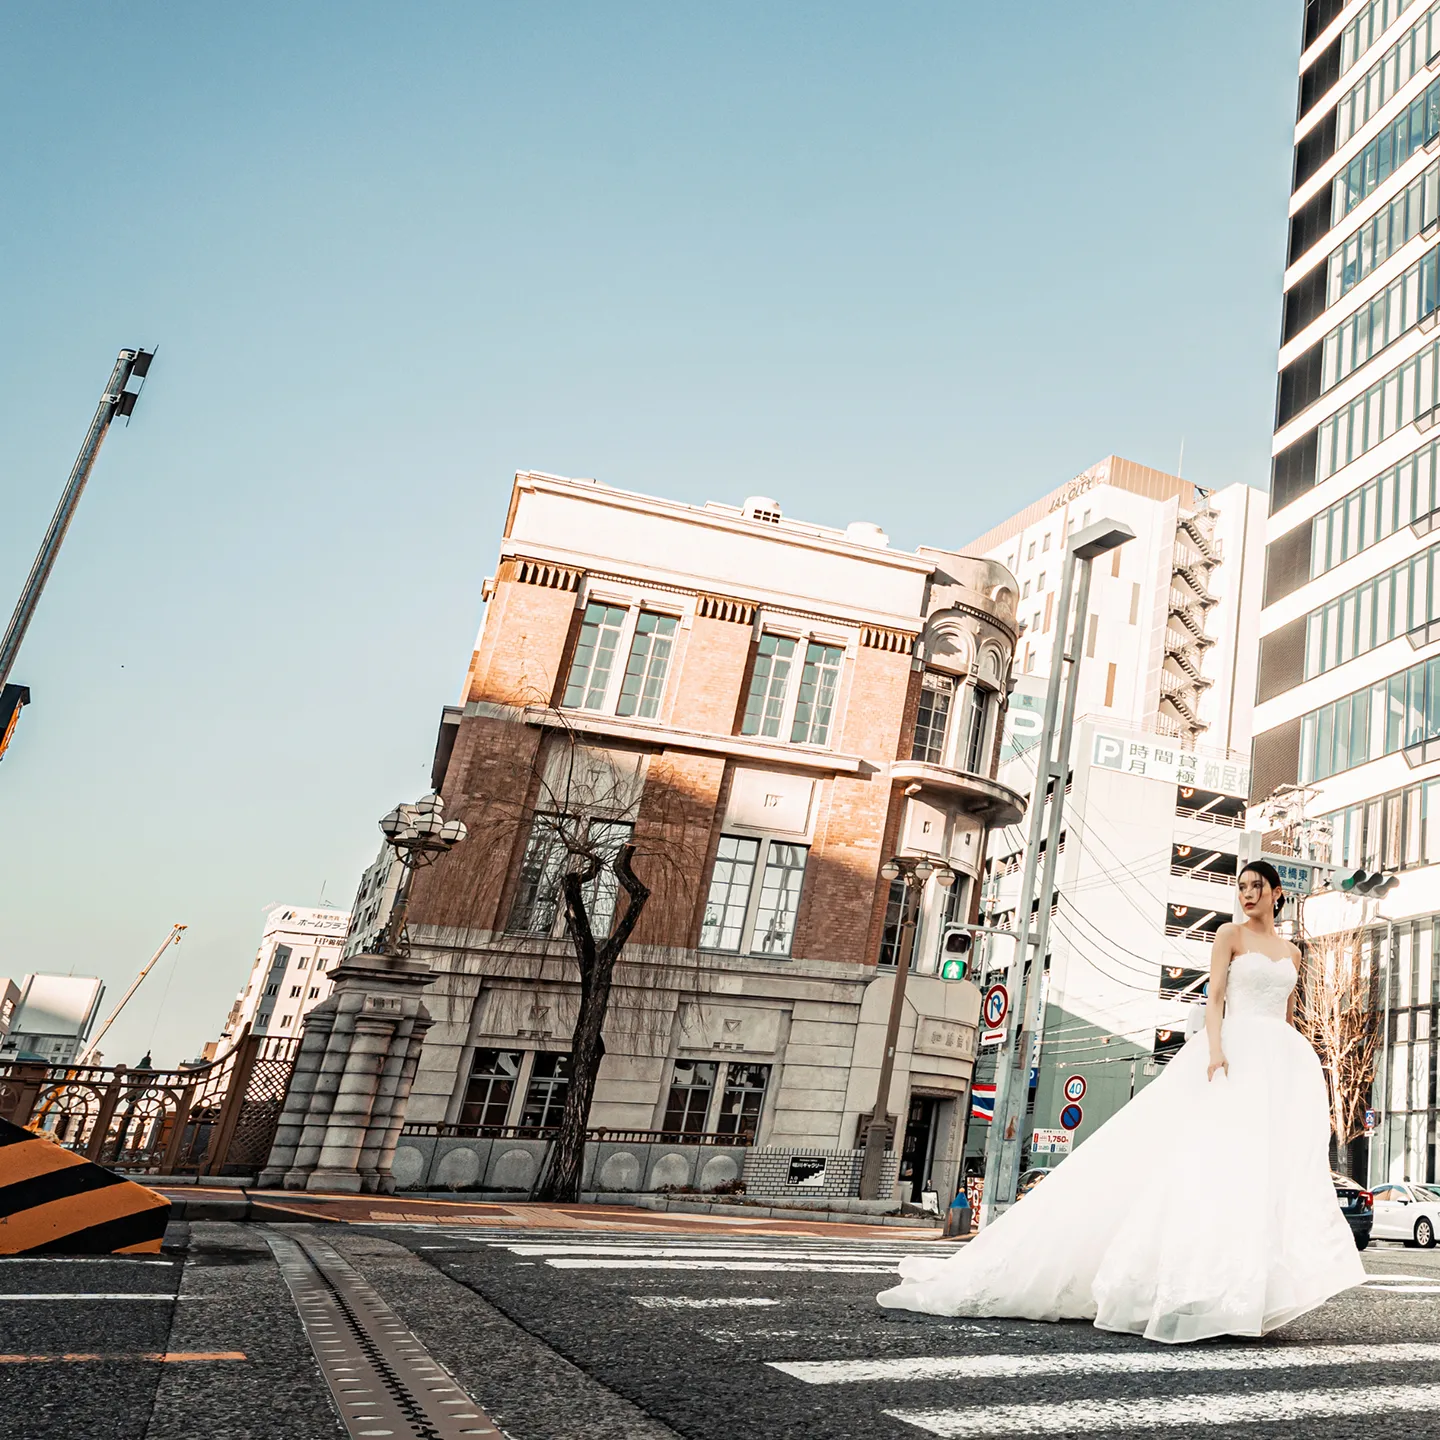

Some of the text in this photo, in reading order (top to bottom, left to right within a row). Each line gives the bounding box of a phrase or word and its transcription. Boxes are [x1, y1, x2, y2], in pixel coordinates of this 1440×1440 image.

[1098, 738, 1120, 764] P
[1129, 743, 1198, 771] 時間貸
[1273, 864, 1308, 882] 屋橋東
[1068, 1082, 1083, 1095] 40
